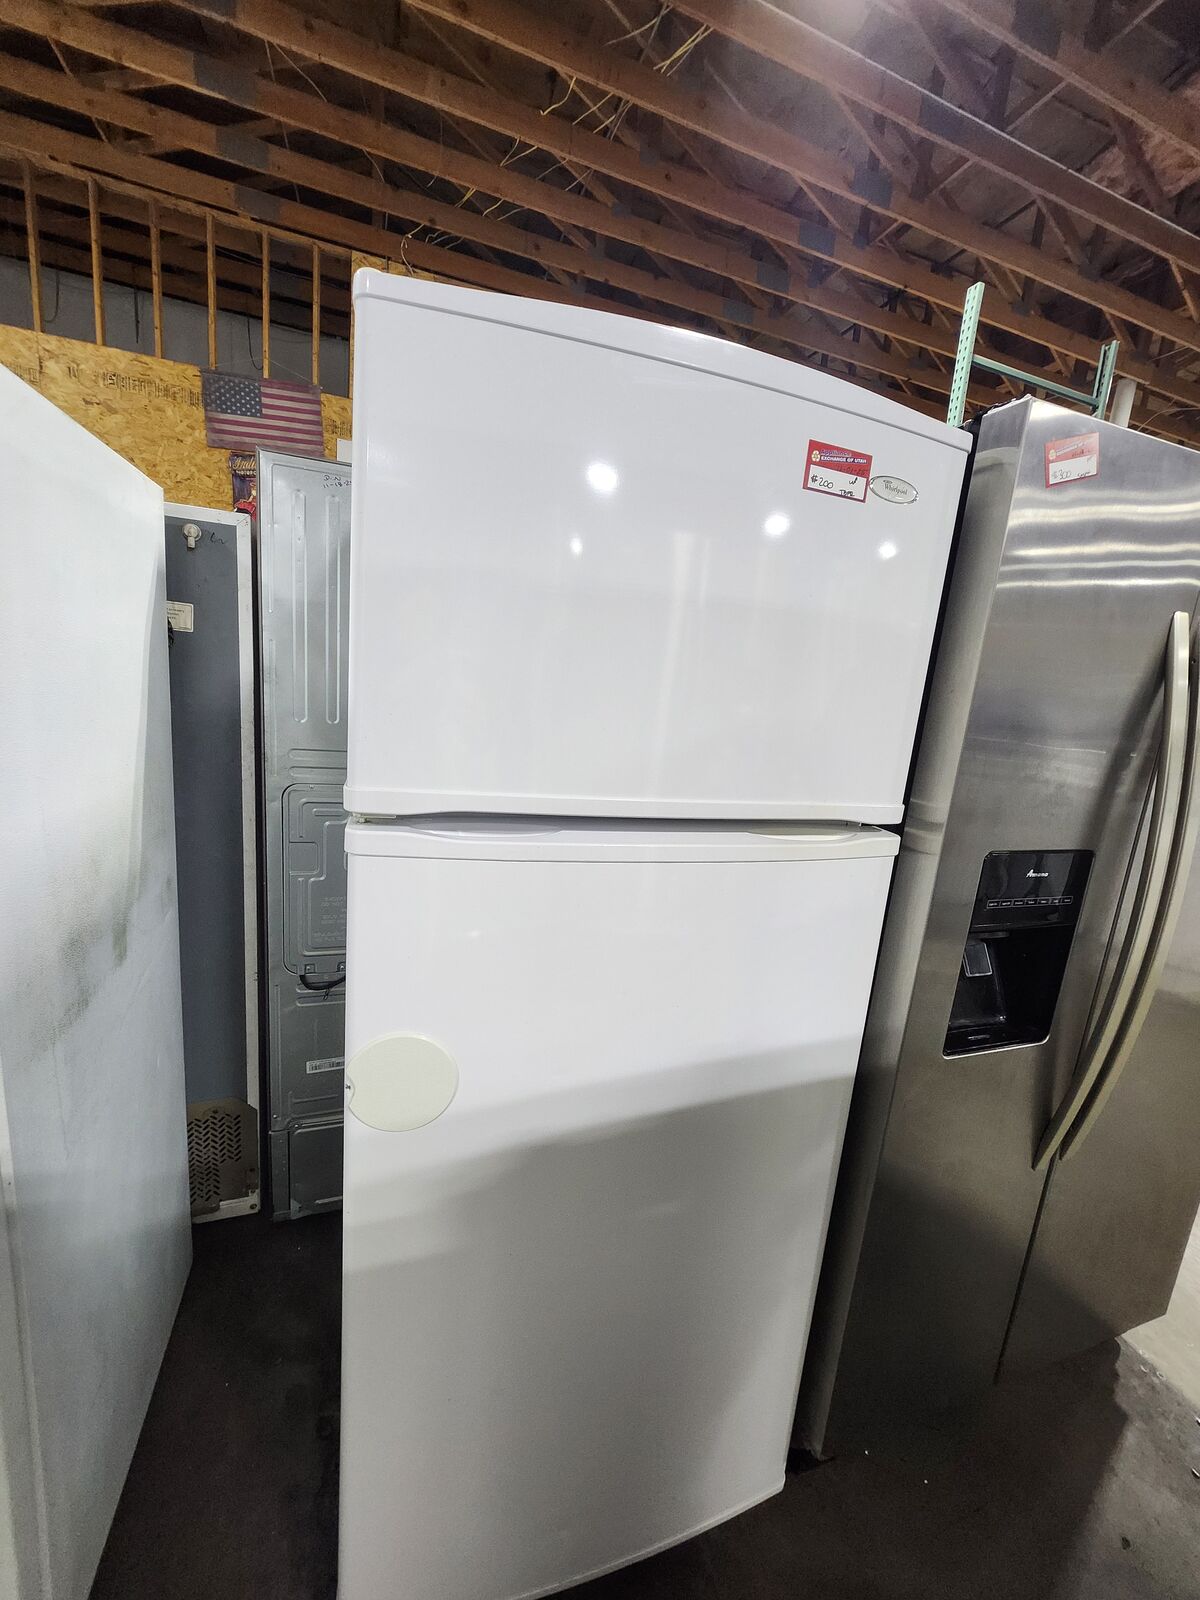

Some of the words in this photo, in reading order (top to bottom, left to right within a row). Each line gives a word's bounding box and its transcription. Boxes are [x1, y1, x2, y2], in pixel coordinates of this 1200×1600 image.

[232, 456, 257, 470] Indi
[884, 483, 908, 496] Whirlpool
[1026, 869, 1049, 878] Amana
